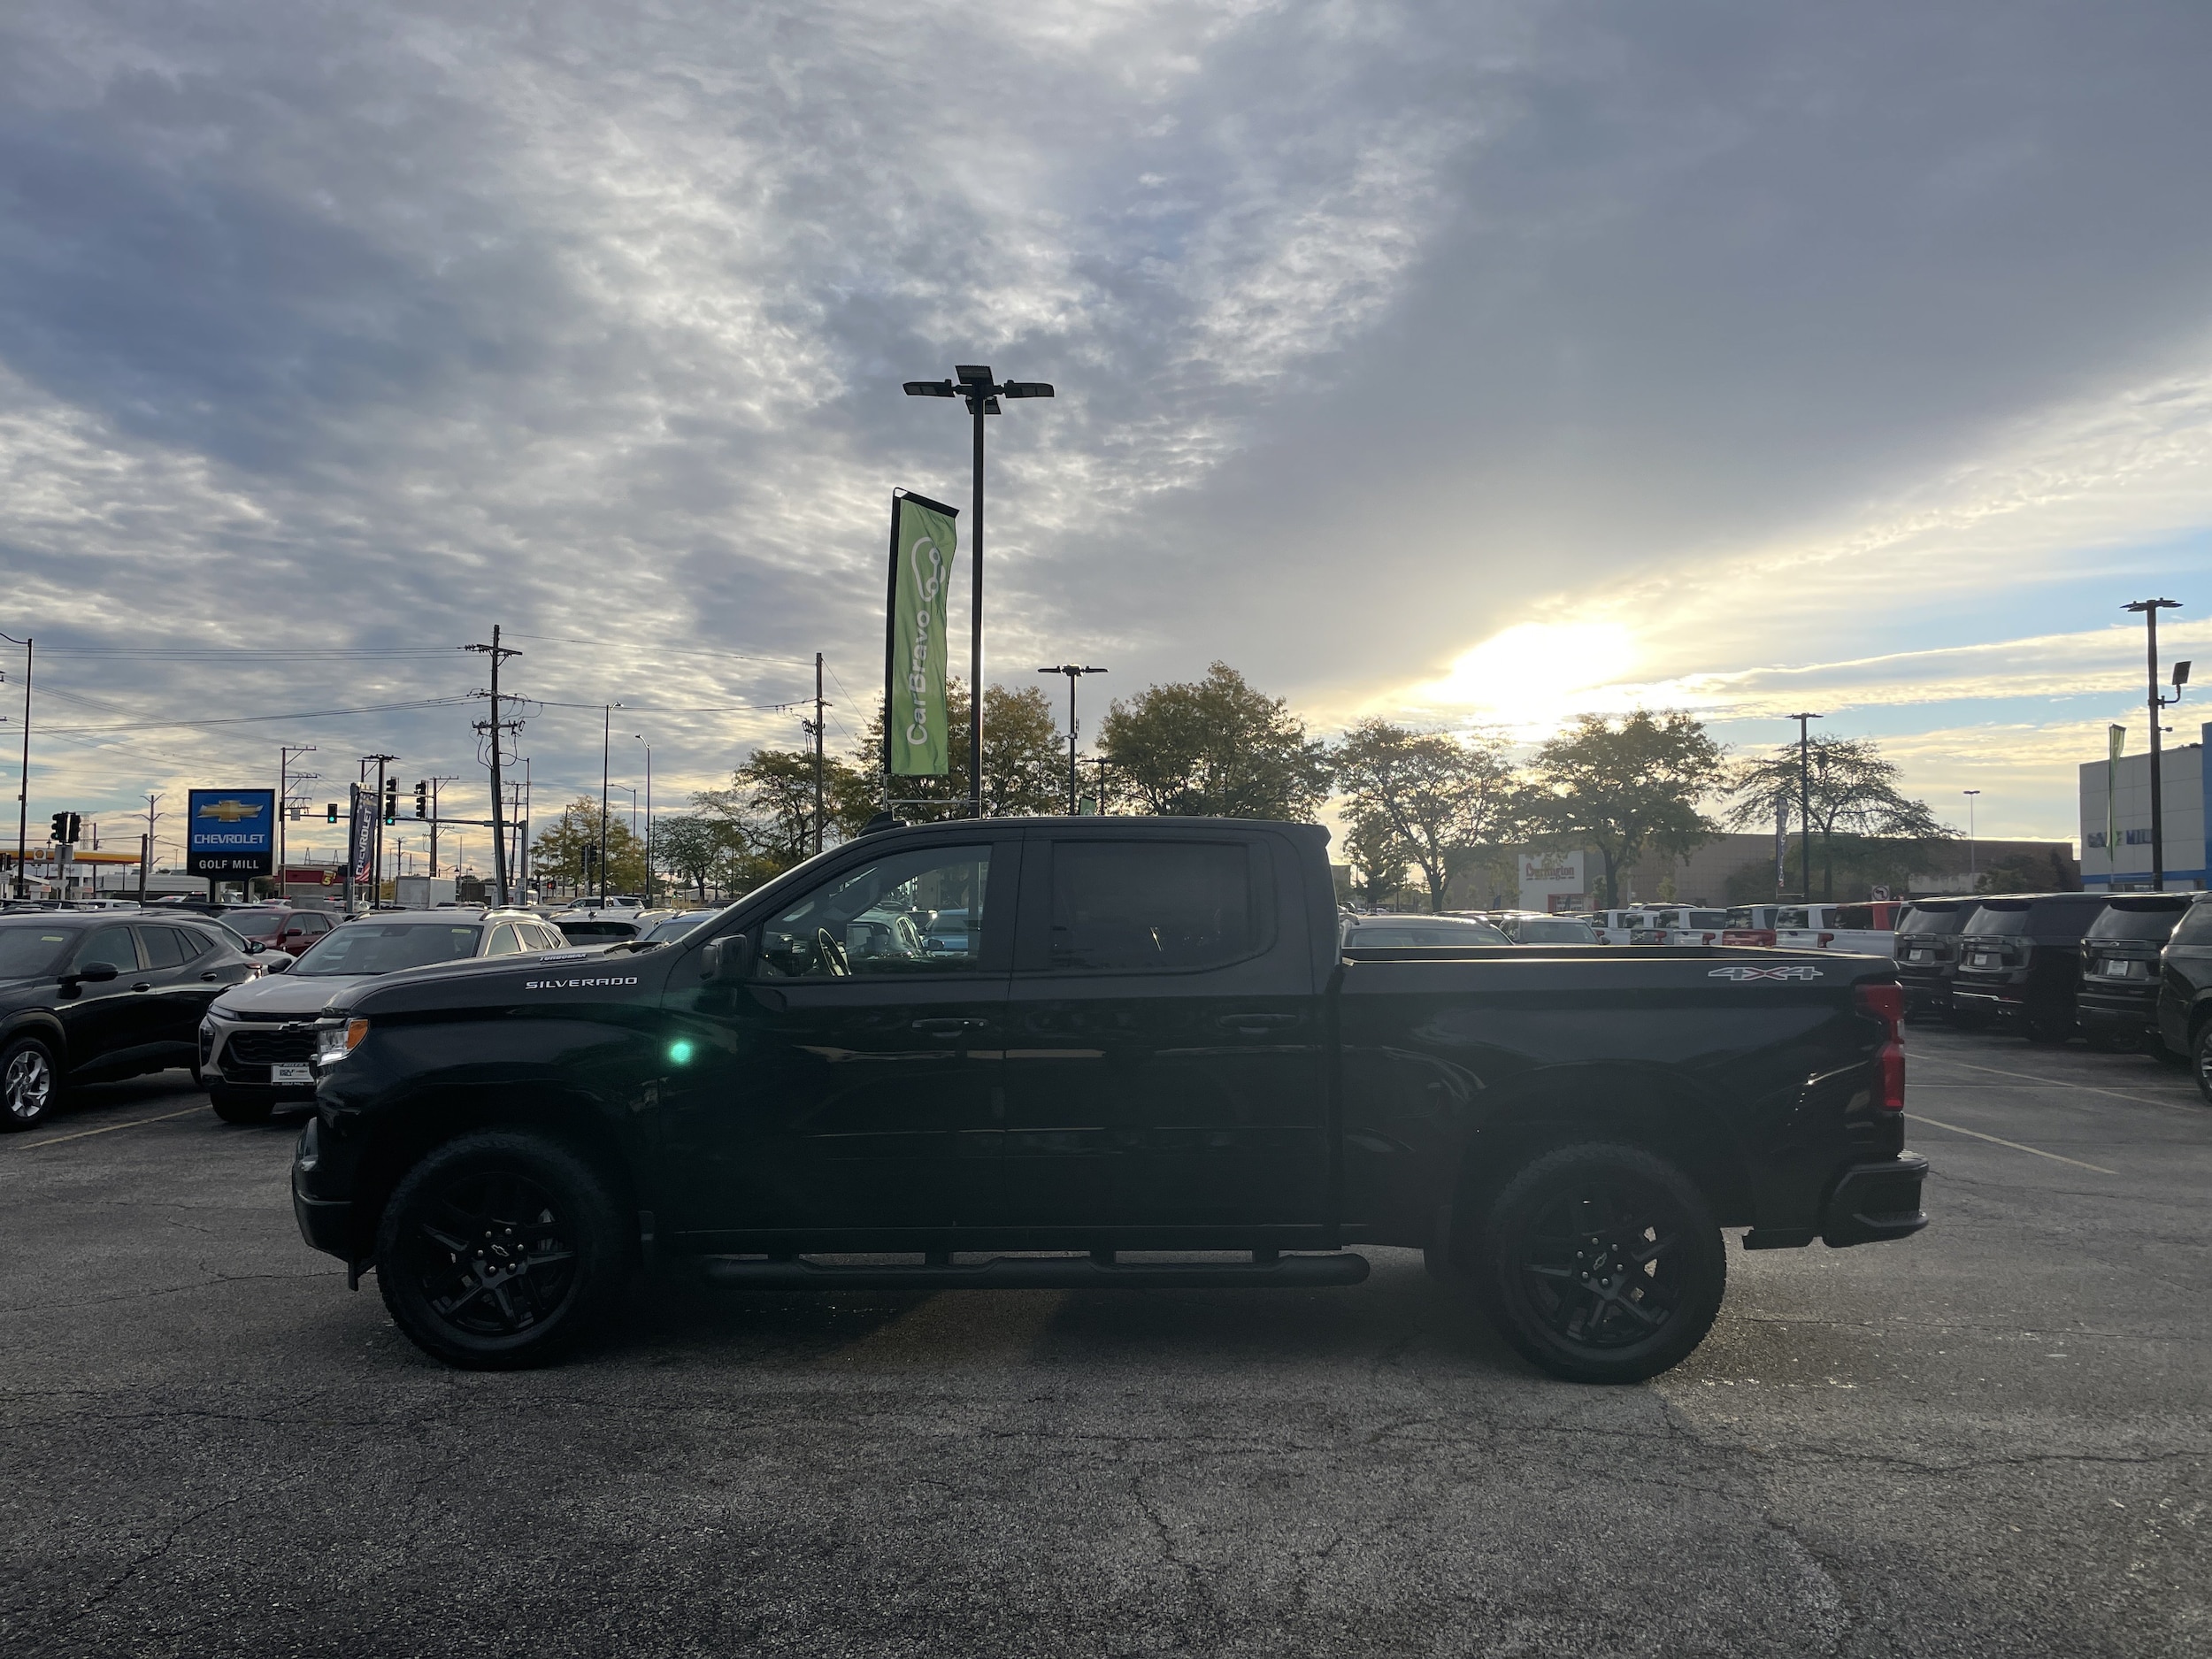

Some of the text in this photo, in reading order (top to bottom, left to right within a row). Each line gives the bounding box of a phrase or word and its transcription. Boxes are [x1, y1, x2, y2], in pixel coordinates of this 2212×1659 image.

[907, 610, 930, 745] CarBravo
[194, 833, 265, 844] CHEVROLET
[356, 808, 372, 876] CHEVROLET
[198, 859, 259, 869] GOLF MILL
[525, 977, 638, 989] SILVERADO
